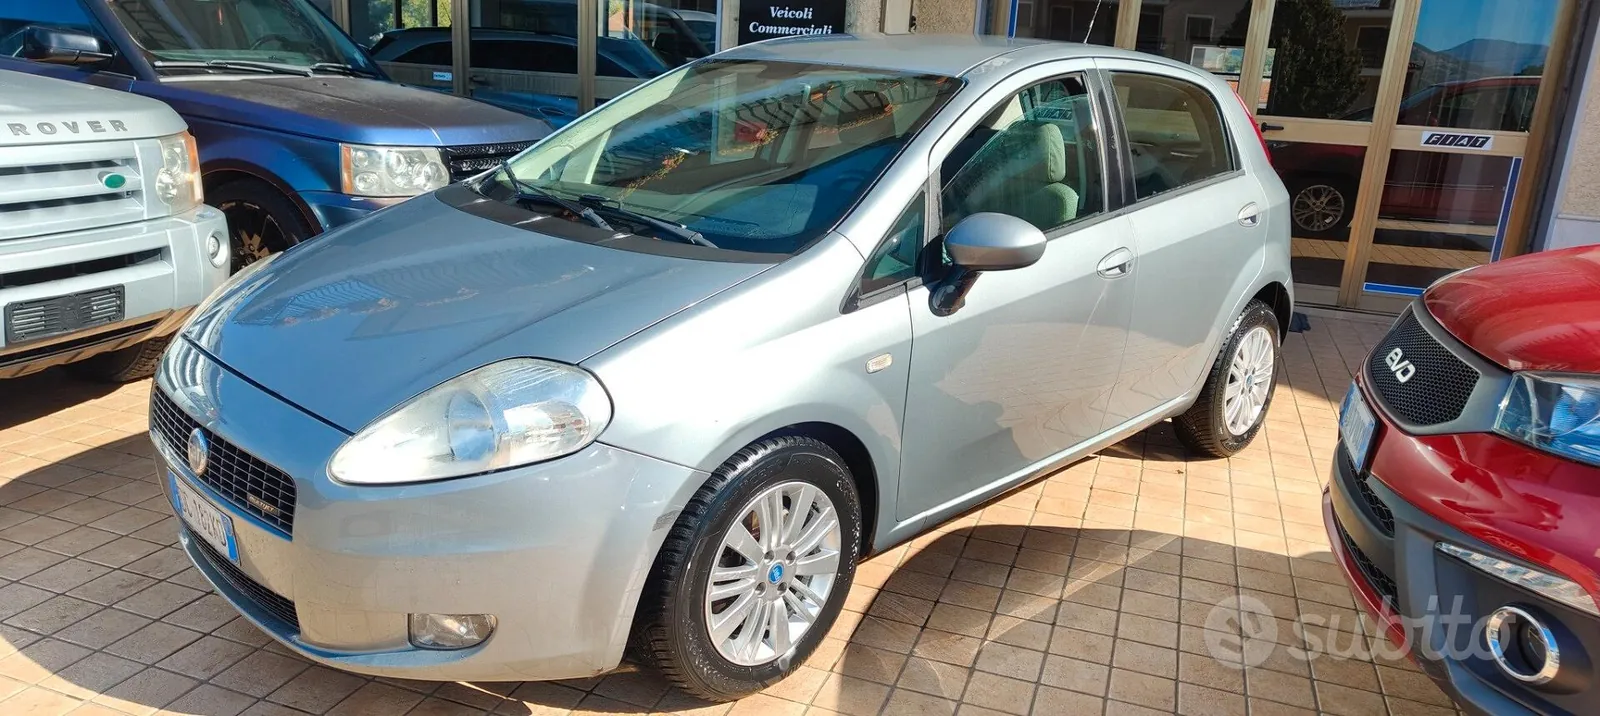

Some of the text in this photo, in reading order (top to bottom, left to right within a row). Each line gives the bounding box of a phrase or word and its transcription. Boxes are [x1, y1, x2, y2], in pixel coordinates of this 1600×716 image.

[769, 6, 813, 19] Veicoli
[749, 22, 832, 35] Commerciali
[7, 120, 128, 136] ROVER
[1427, 134, 1488, 147] FIAT
[1385, 347, 1416, 383] EVO
